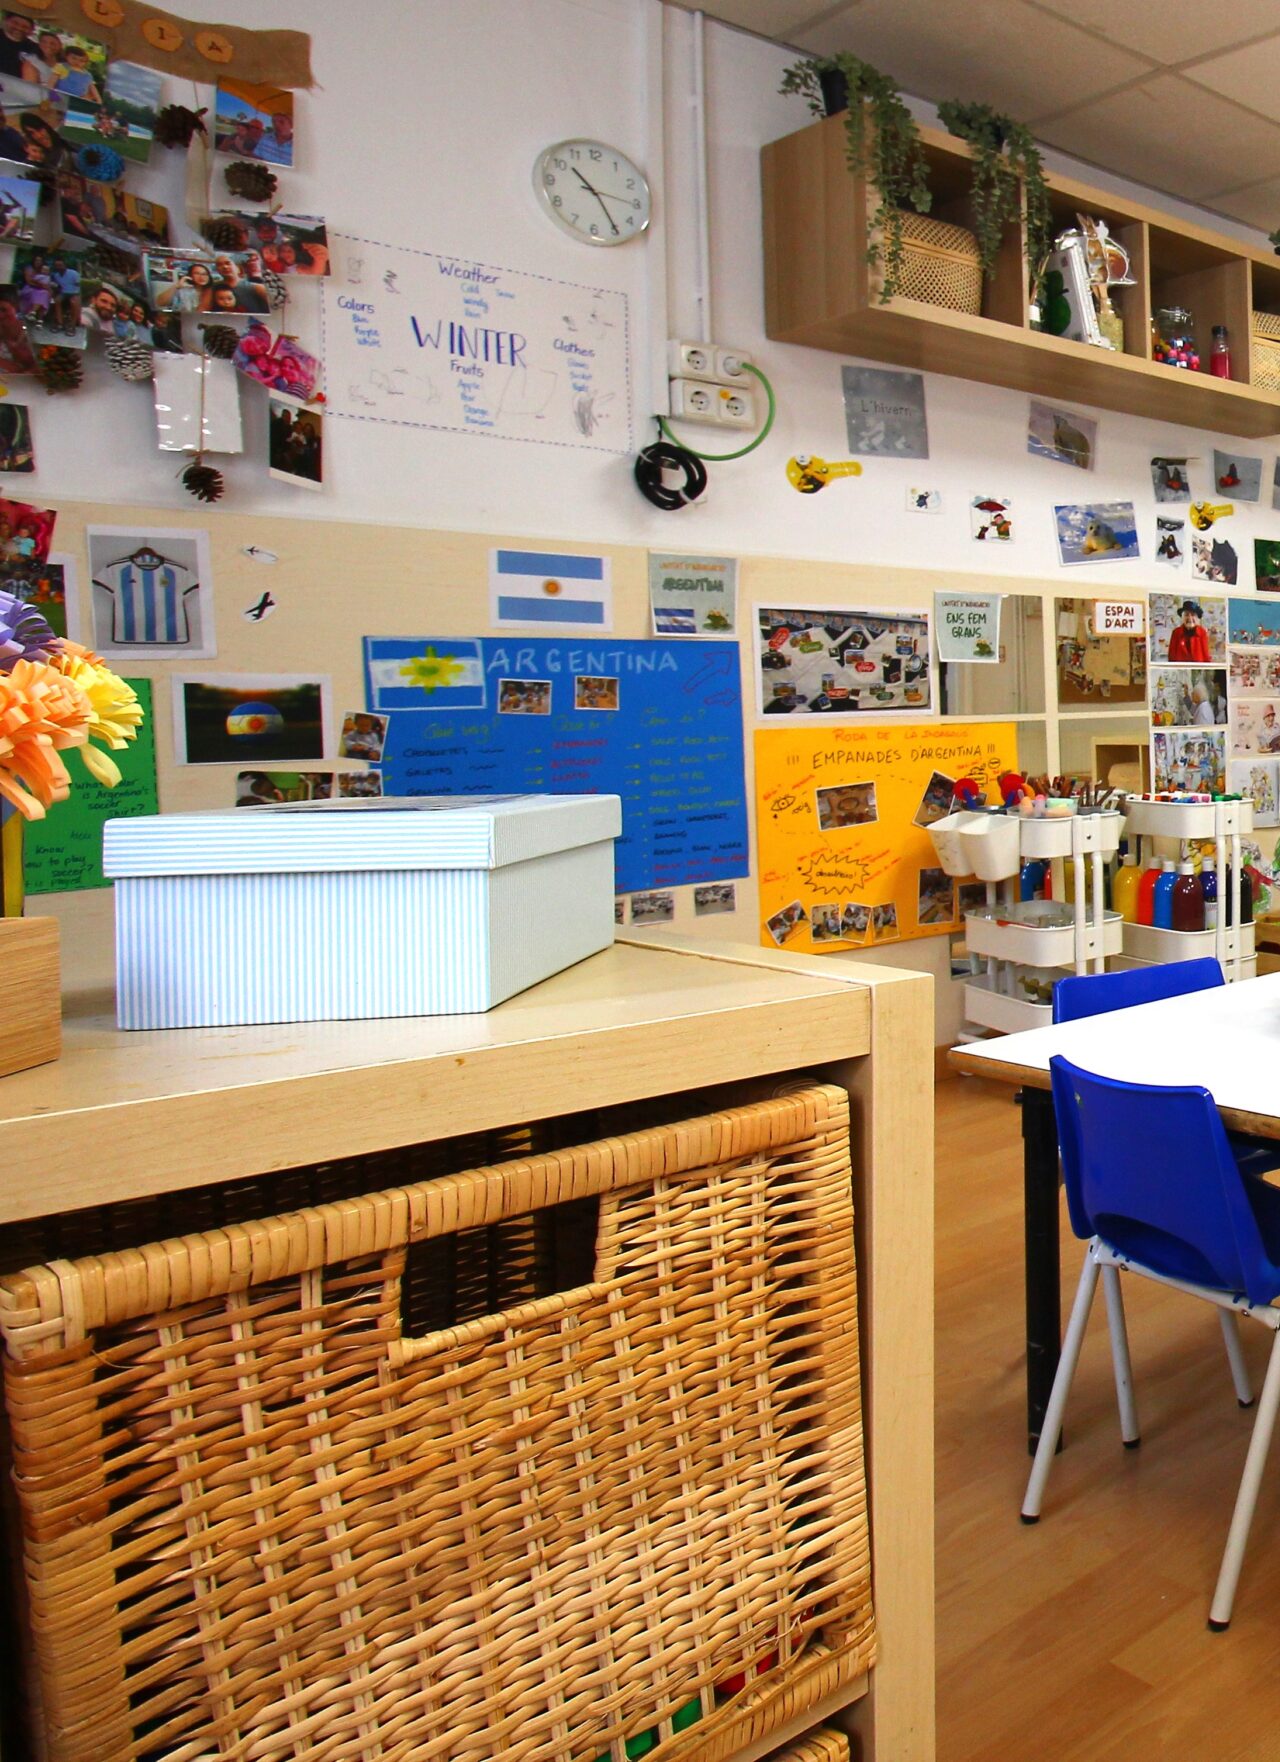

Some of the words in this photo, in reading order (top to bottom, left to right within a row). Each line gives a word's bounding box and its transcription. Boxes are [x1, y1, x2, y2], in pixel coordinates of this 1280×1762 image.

[589, 149, 602, 162] 12
[554, 158, 567, 171] 10
[546, 174, 555, 186] 9
[626, 178, 635, 190] 2
[553, 195, 562, 207] 8
[571, 213, 579, 224] 7
[590, 224, 598, 236] 6
[439, 261, 501, 284] Weather
[337, 296, 375, 313] Colors
[410, 315, 527, 368] WINTER
[553, 338, 596, 357] Clothes
[450, 360, 485, 378] Fruits
[1105, 605, 1134, 616] ESPAI
[946, 612, 965, 624] ENS
[968, 612, 987, 624] FEM
[1105, 618, 1135, 628] D'ART
[952, 626, 982, 639] GRANS
[487, 647, 678, 674] ARGENTINA
[812, 749, 902, 770] EMPANADES
[911, 744, 983, 762] D'ARGENTINA
